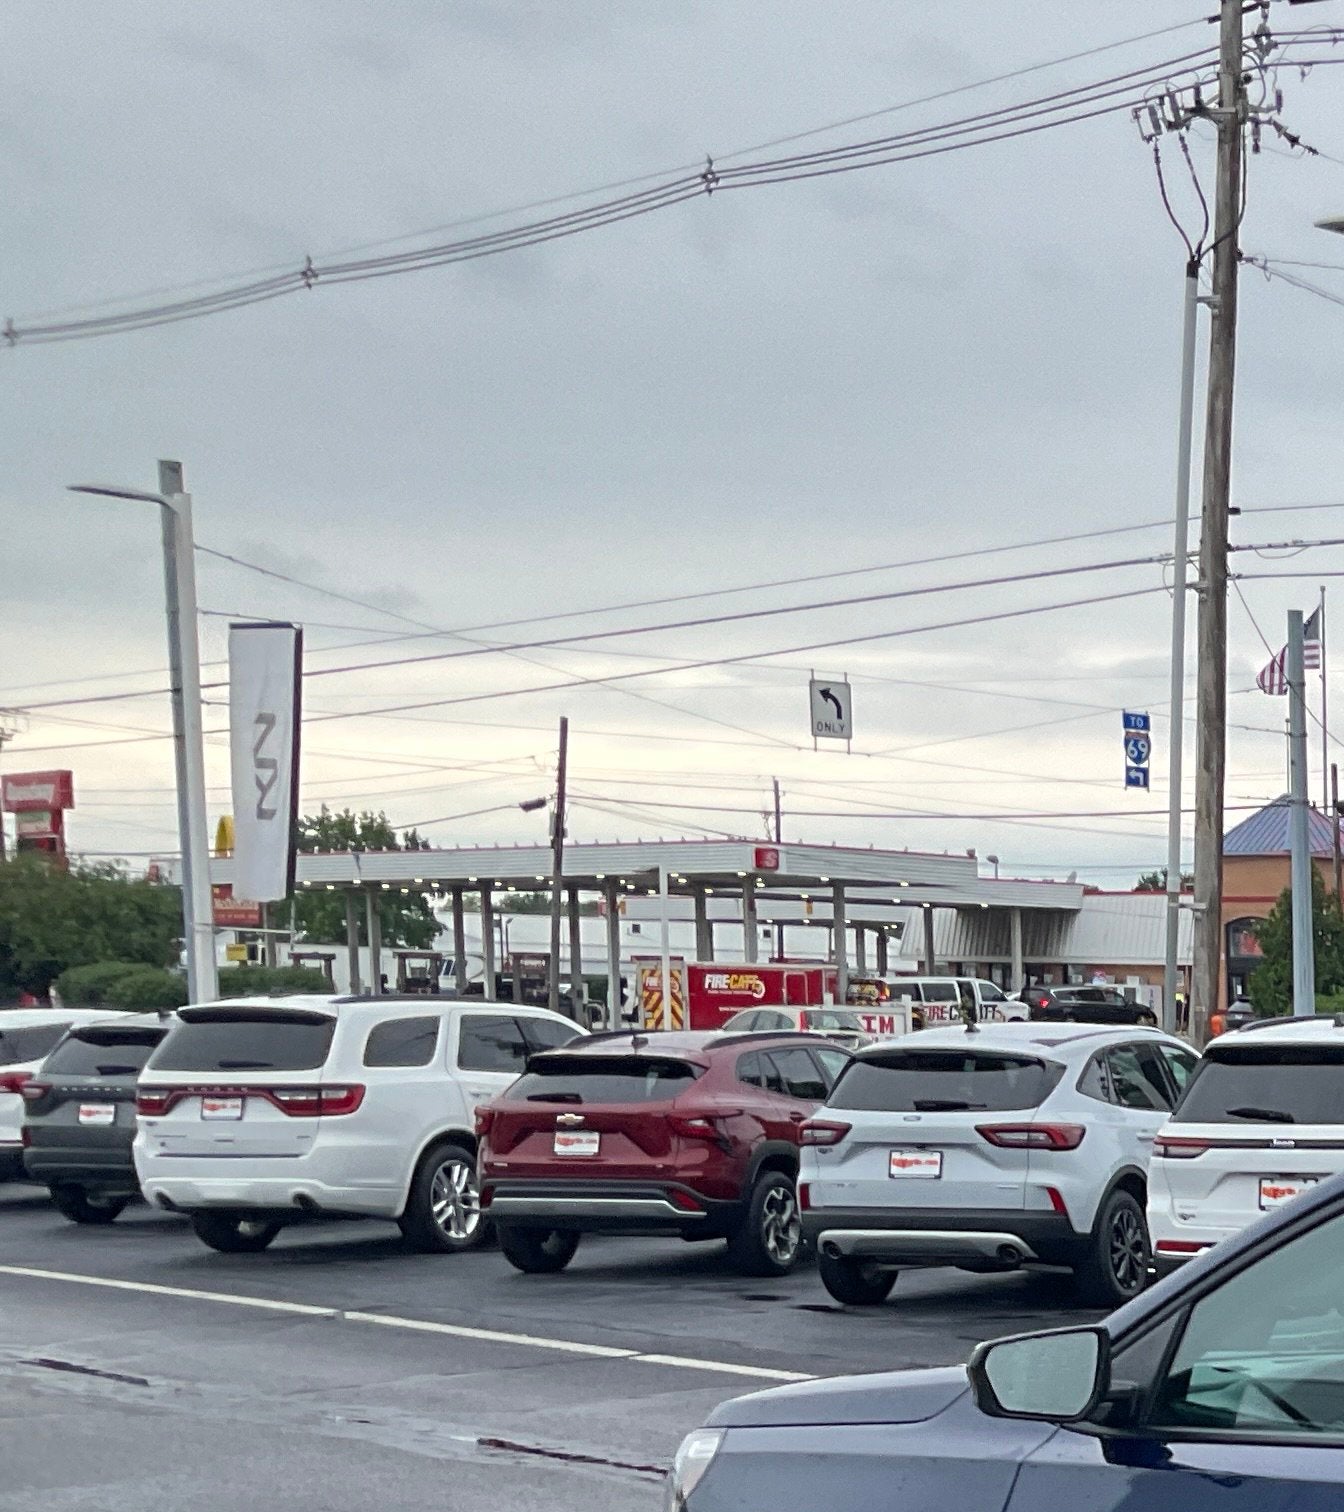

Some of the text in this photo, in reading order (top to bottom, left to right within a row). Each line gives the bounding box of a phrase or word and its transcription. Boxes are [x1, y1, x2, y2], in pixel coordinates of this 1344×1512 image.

[816, 720, 846, 734] ONLY
[1129, 715, 1144, 728] TO
[1127, 738, 1149, 760] 69
